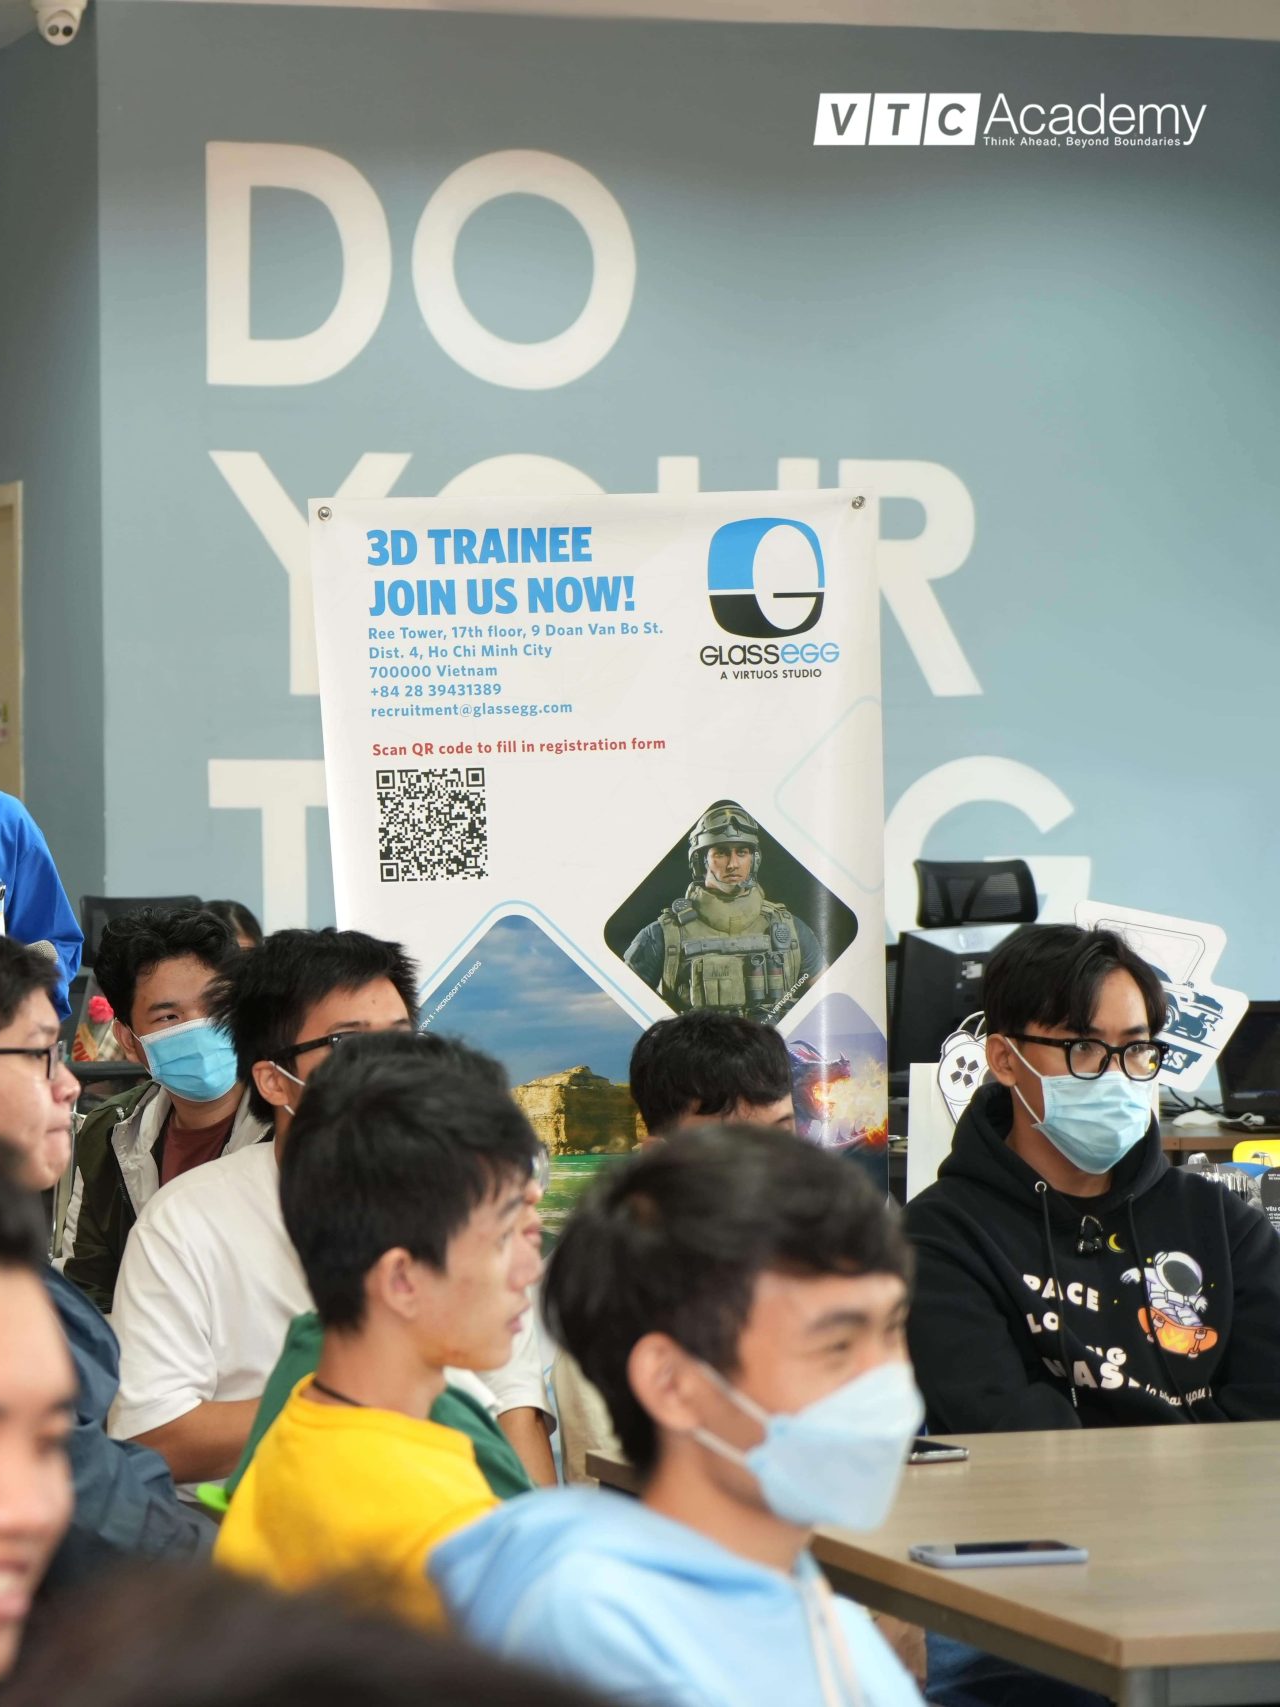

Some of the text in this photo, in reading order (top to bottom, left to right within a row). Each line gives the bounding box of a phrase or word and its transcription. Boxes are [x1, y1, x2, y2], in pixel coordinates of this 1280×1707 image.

[205, 140, 637, 391] DO
[366, 526, 593, 567] 3D TRAINEE
[208, 451, 986, 697] YR
[368, 575, 635, 617] JOIN US NOW!
[368, 622, 664, 641] Ree Tower, 17th floor, 9 Doan Van Bo St.
[369, 643, 553, 661] Dist. 4, Ho Chi Minh City
[370, 664, 498, 679] 700000 Vietnam
[720, 668, 822, 680] A VIRTUOS STUDIO
[370, 683, 502, 698] +84 28 39431389
[371, 701, 573, 718] recruitment@glassegg.com
[372, 737, 666, 757] Scan QR code to fill in registration form
[435, 981, 462, 1013] MICROSOFT
[460, 960, 482, 984] STUDIOS
[771, 991, 792, 1014] VIRTUOS
[790, 973, 809, 993] STUDIO
